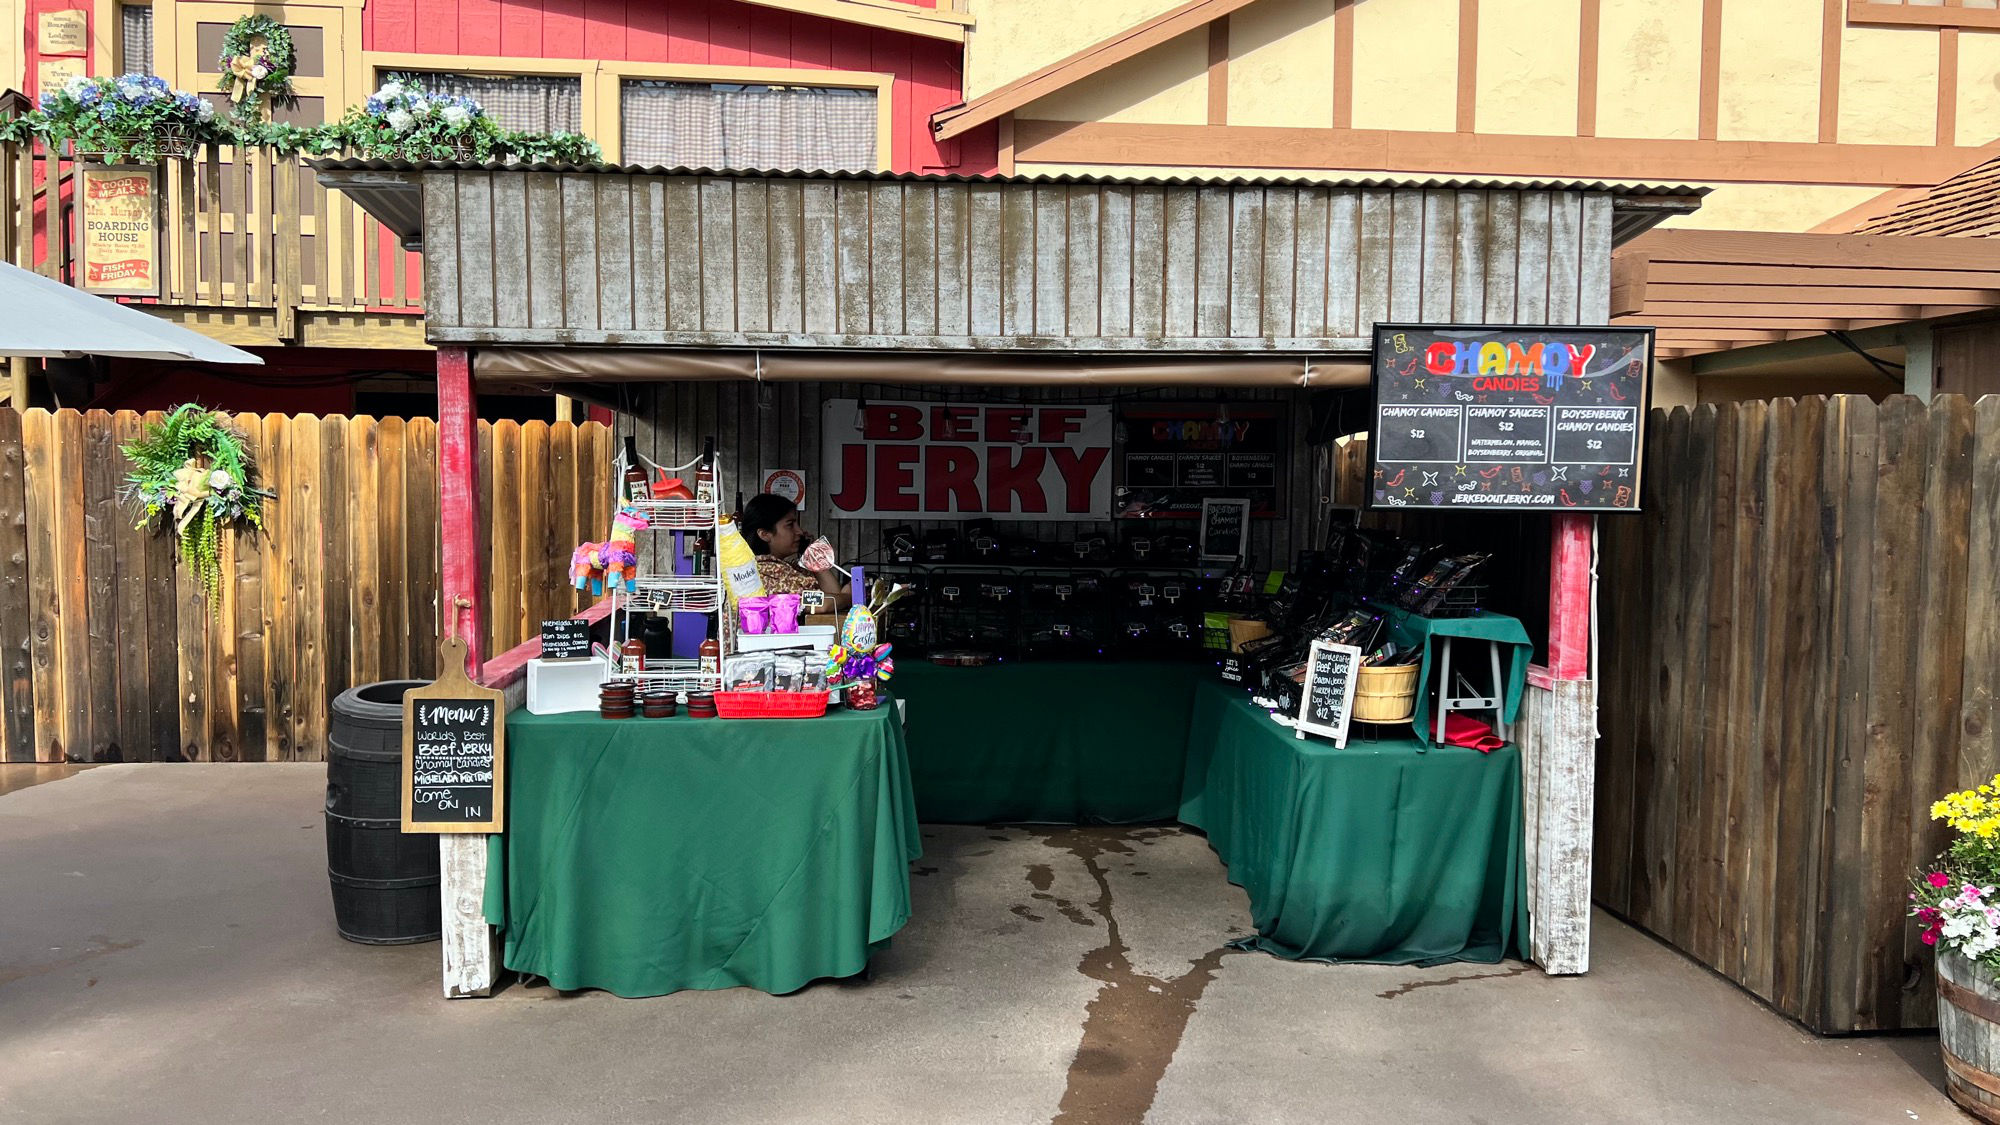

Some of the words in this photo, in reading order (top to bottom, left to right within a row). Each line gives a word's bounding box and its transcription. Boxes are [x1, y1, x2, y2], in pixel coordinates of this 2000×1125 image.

[101, 178, 132, 190] GOOD
[98, 186, 137, 198] MEALS
[88, 221, 149, 231] BOARDING
[98, 233, 138, 242] HOUSE
[102, 262, 125, 273] FISH
[100, 269, 137, 281] FRIDAY
[1425, 341, 1597, 379] CHAMOY
[1472, 378, 1540, 392] CANDIES
[1382, 407, 1419, 418] CHAMOY
[1420, 408, 1459, 418] CANDIES
[1469, 408, 1507, 418] CHAMOY
[1508, 408, 1547, 418] SAUCES:
[1561, 409, 1628, 420] BOYSENBERRY
[862, 404, 1087, 443] BEEF
[1498, 421, 1514, 431] $12
[1556, 422, 1593, 432] CHAMOY
[1595, 422, 1634, 432] CANDIES
[1151, 420, 1251, 443] CHAMOY
[1410, 428, 1425, 439] $12
[1586, 439, 1603, 450] $12
[829, 443, 1112, 514] JERKY
[1451, 493, 1555, 504] JERKEDOUTJERKY.COM
[427, 705, 482, 726] Menu
[418, 742, 457, 756] Beef
[438, 800, 459, 810] ON
[465, 805, 481, 818] IN
